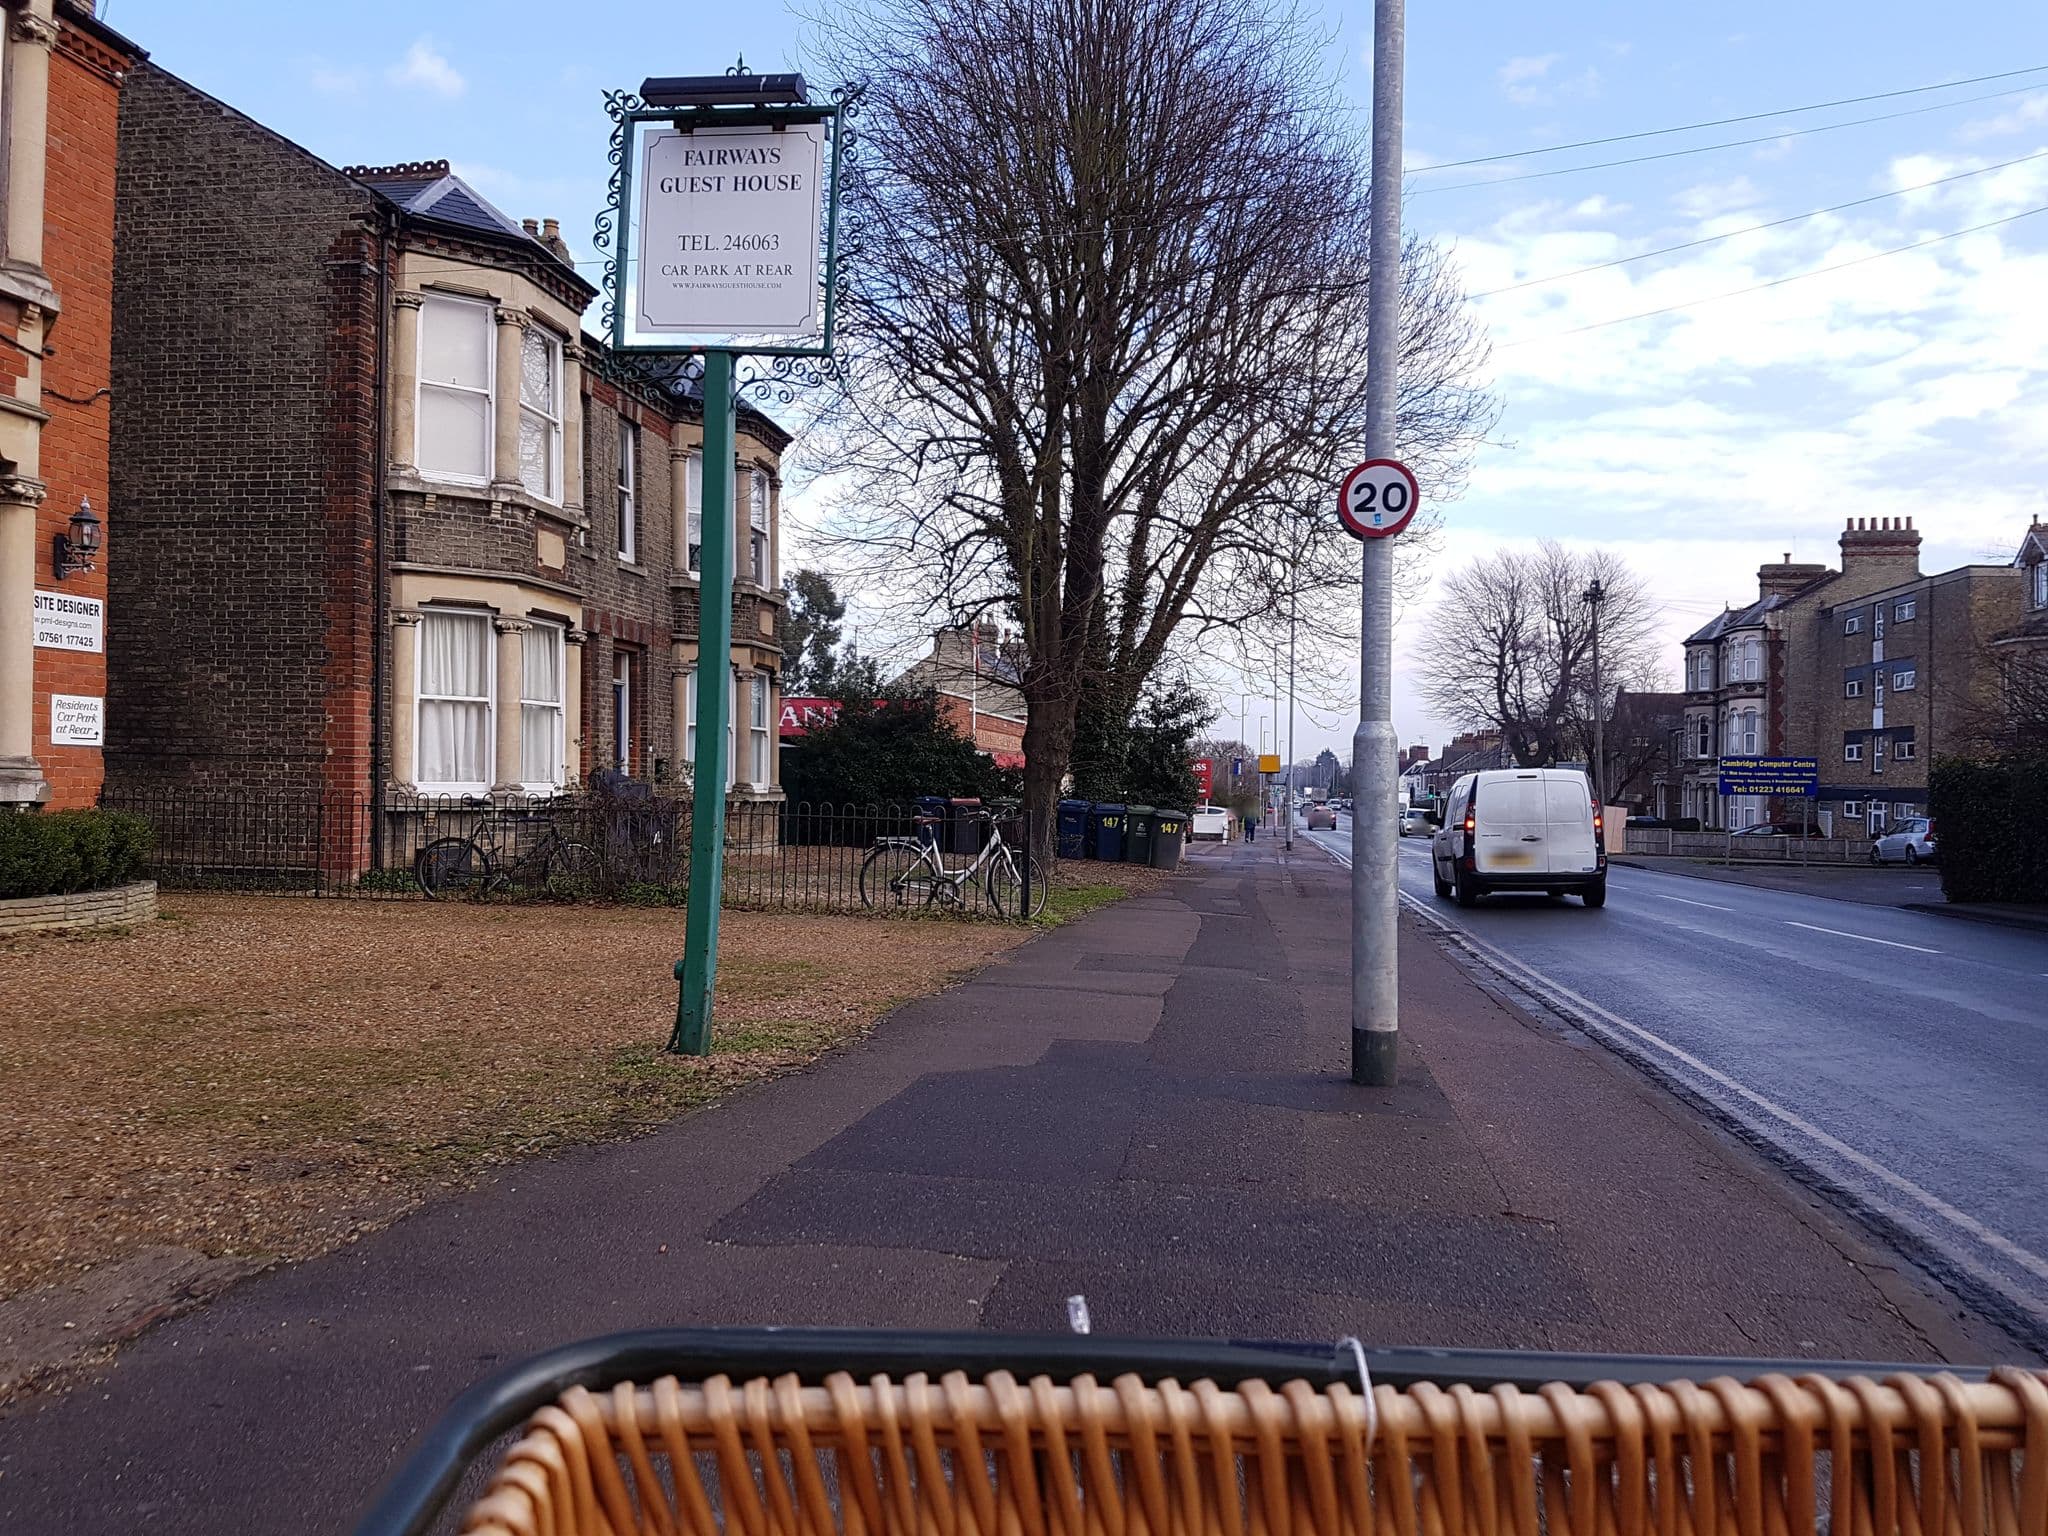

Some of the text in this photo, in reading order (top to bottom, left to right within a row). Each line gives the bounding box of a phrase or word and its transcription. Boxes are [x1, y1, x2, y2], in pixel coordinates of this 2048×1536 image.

[684, 148, 781, 166] FAIRWAYS
[660, 174, 802, 193] GUEST HOUSE
[678, 234, 780, 251] TEL. 246063
[661, 264, 793, 276] CAR PARK AT REAR
[1353, 482, 1408, 512] 20
[34, 595, 100, 617] SITE DESIGNER
[39, 631, 94, 647] 07561 177425
[55, 699, 99, 711] Residents
[57, 711, 97, 724] Car Park
[55, 724, 92, 735] at Rear
[1721, 760, 1757, 769] Cambridge
[1759, 760, 1791, 769] Computer
[1732, 785, 1748, 793] Tel:
[1102, 817, 1119, 829] 147
[1161, 823, 1178, 834] 147
